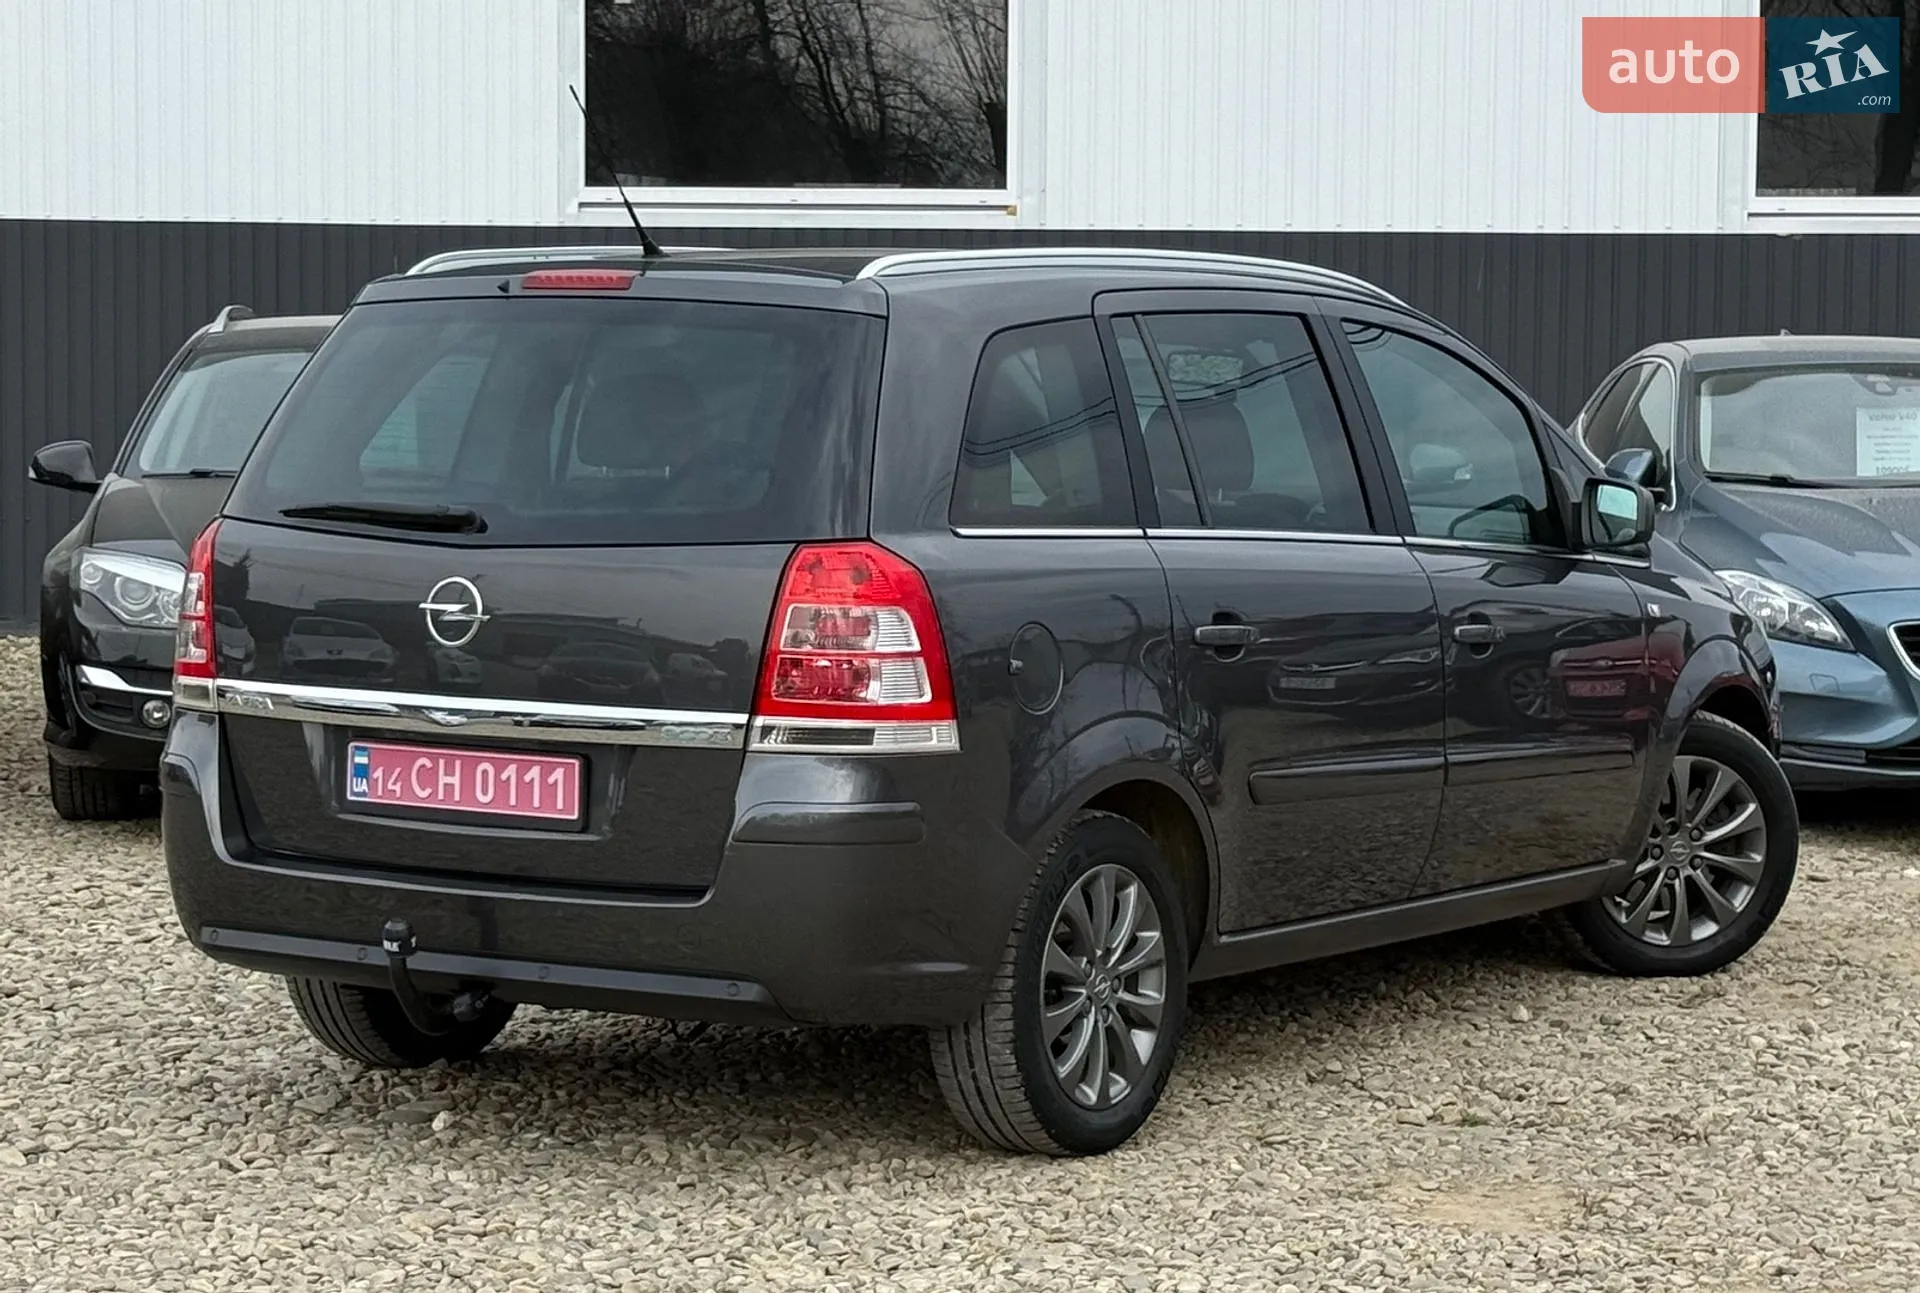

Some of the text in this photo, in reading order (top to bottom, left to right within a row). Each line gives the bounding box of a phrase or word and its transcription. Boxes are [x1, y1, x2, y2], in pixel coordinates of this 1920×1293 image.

[352, 777, 369, 793] UA
[372, 757, 565, 810] 14 CH 0111
